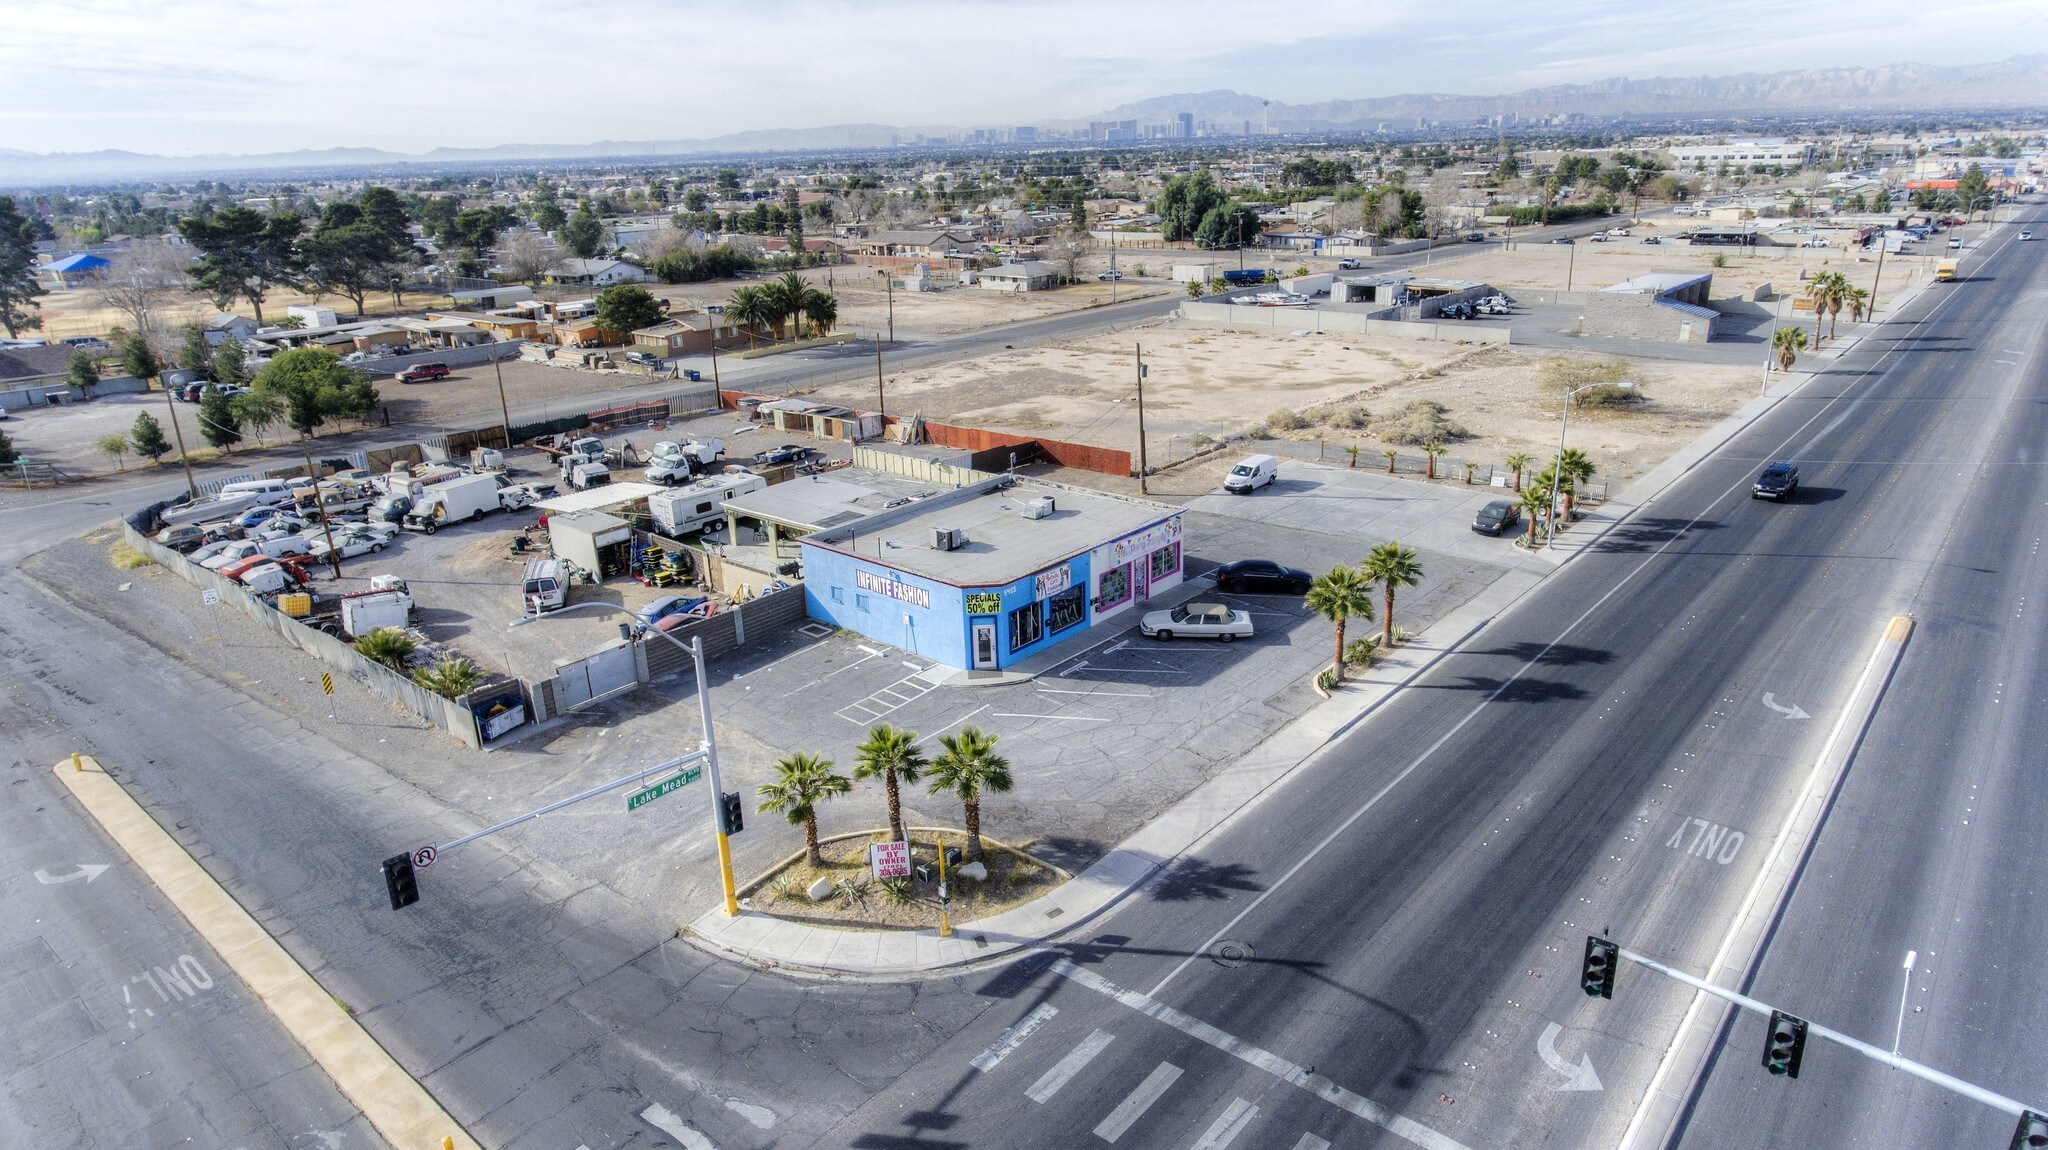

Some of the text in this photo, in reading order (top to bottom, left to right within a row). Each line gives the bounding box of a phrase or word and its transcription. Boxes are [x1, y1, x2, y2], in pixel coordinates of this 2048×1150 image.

[857, 570, 929, 608] INFINITE FASHION
[205, 596, 217, 604] 25
[965, 593, 1001, 603] SPECIALS
[967, 602, 1000, 614] 50% off
[633, 790, 657, 808] Lake
[661, 774, 687, 795] Mead
[1665, 816, 1745, 865] ONLY
[877, 842, 905, 853] FOR SALE
[878, 856, 906, 866] OWNER
